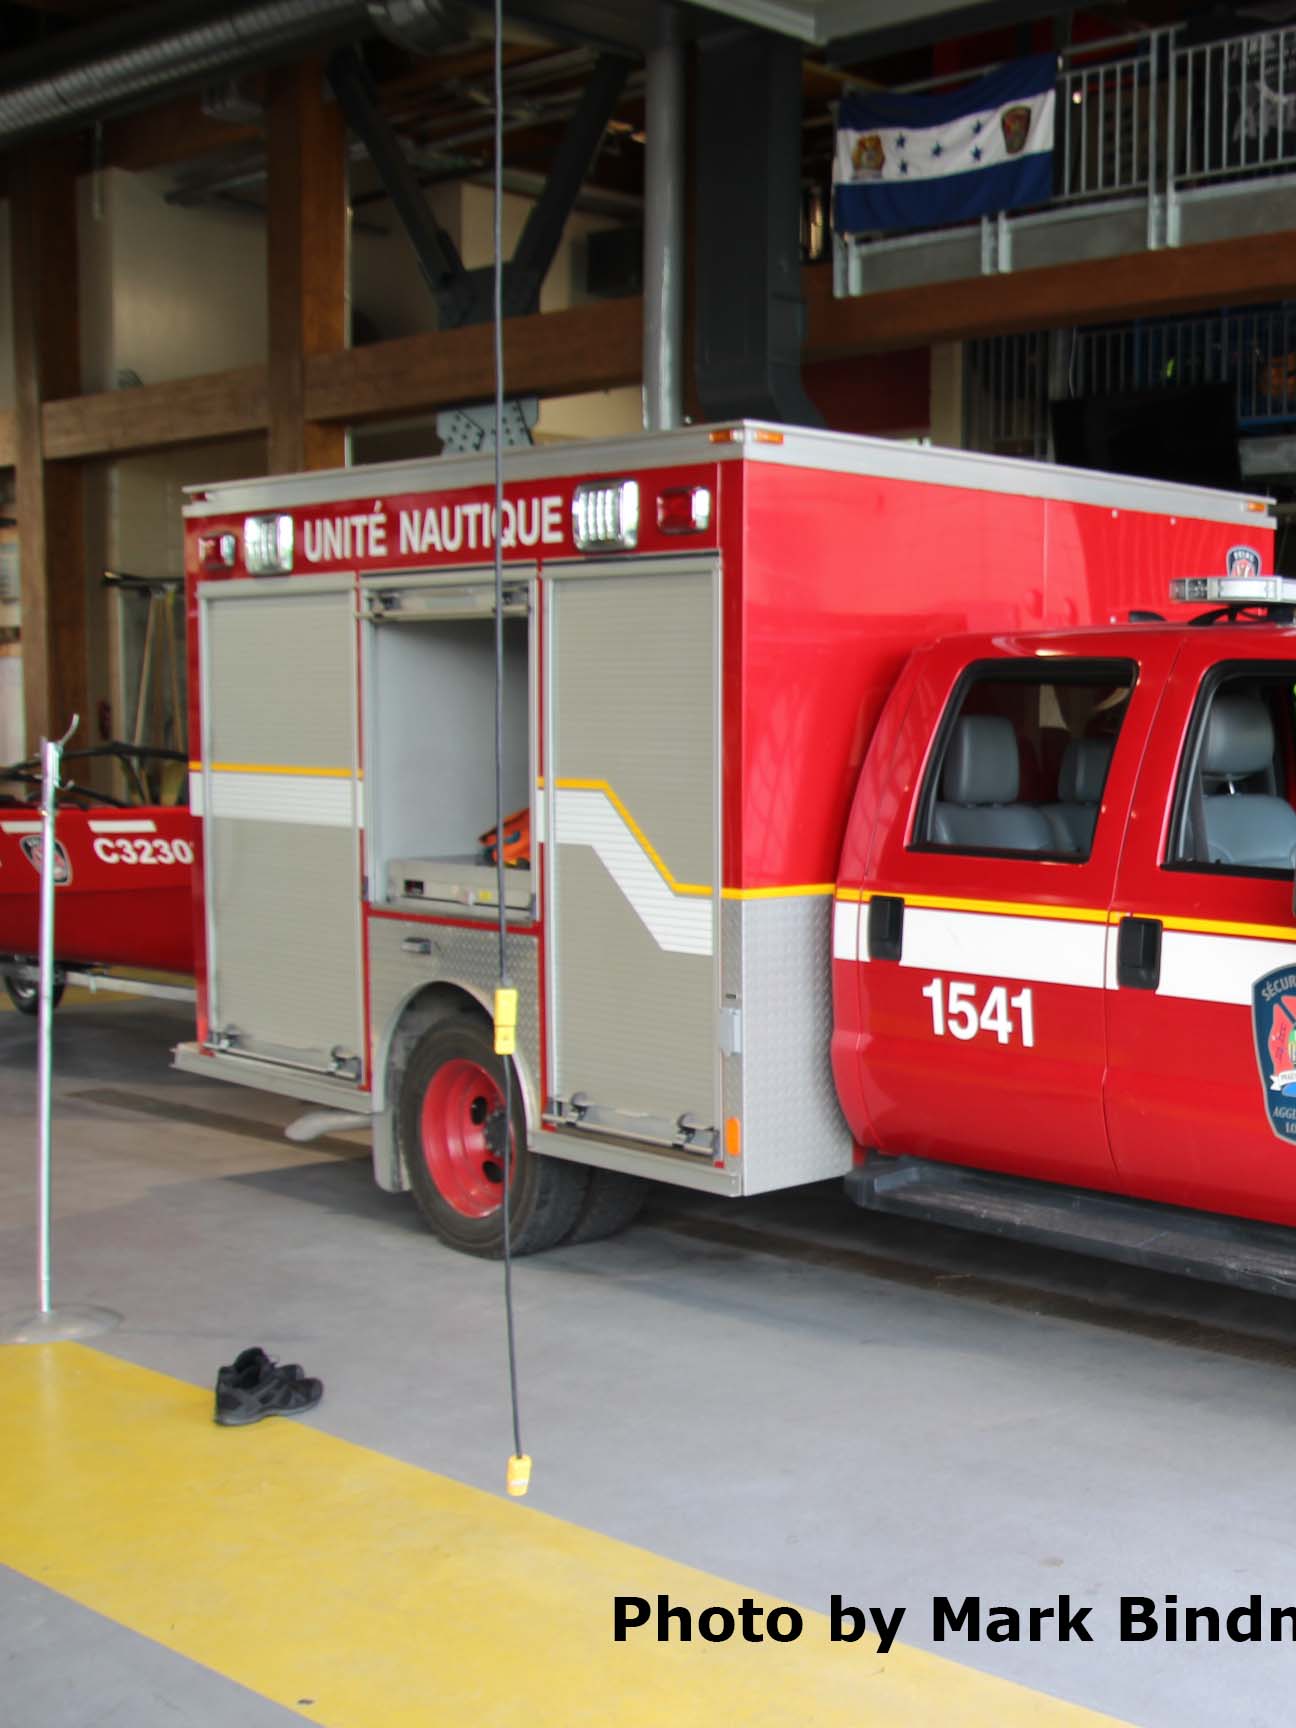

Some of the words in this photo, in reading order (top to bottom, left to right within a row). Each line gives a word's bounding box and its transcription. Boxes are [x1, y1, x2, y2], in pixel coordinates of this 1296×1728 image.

[303, 500, 388, 563] UNITÉ
[400, 495, 564, 555] NAUTIQUE
[93, 837, 195, 865] C3230
[922, 976, 1035, 1048] 1541
